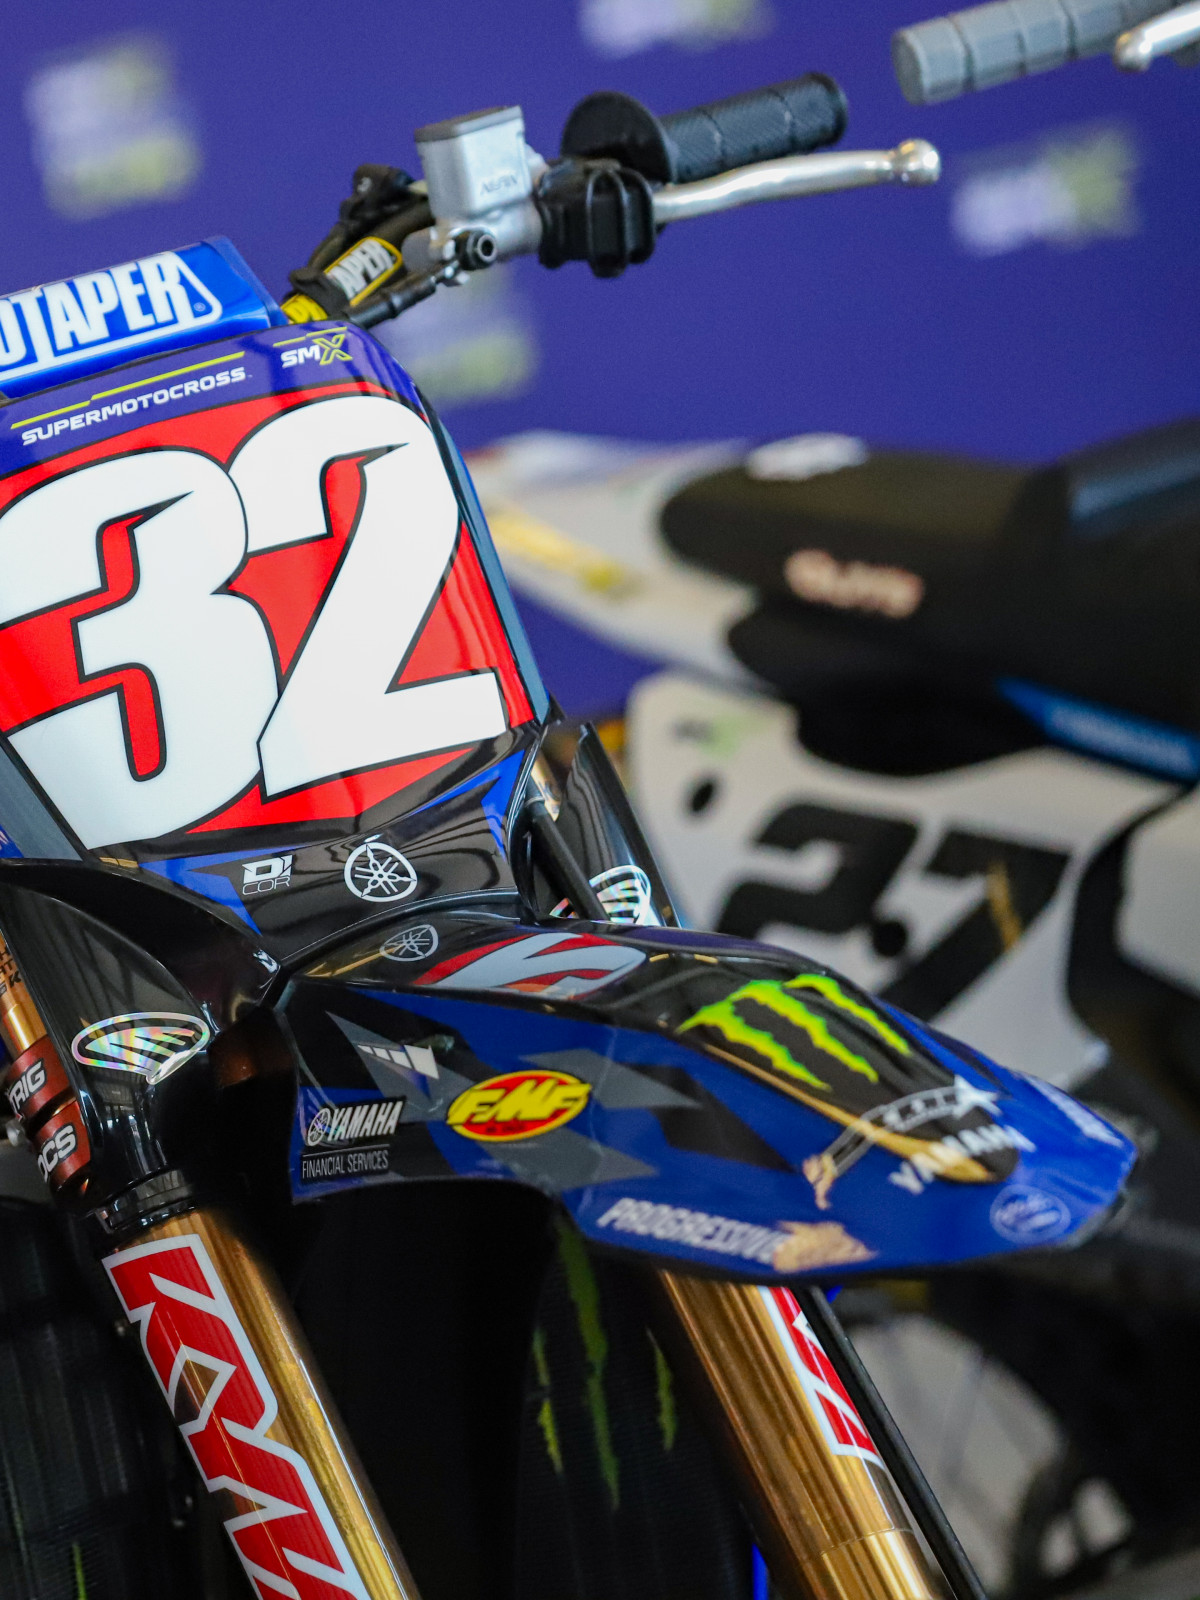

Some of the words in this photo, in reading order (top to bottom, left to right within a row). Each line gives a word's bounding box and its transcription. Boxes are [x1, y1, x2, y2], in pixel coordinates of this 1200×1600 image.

[281, 333, 353, 367] SMX
[21, 367, 247, 446] SUPERMOTOCROSS
[242, 876, 291, 896] COR
[714, 803, 1074, 1023] 27
[327, 1101, 404, 1142] YAMAHA
[447, 1079, 592, 1126] FMF
[302, 1156, 346, 1180] FINANCIAL
[347, 1149, 389, 1174] SERVICES
